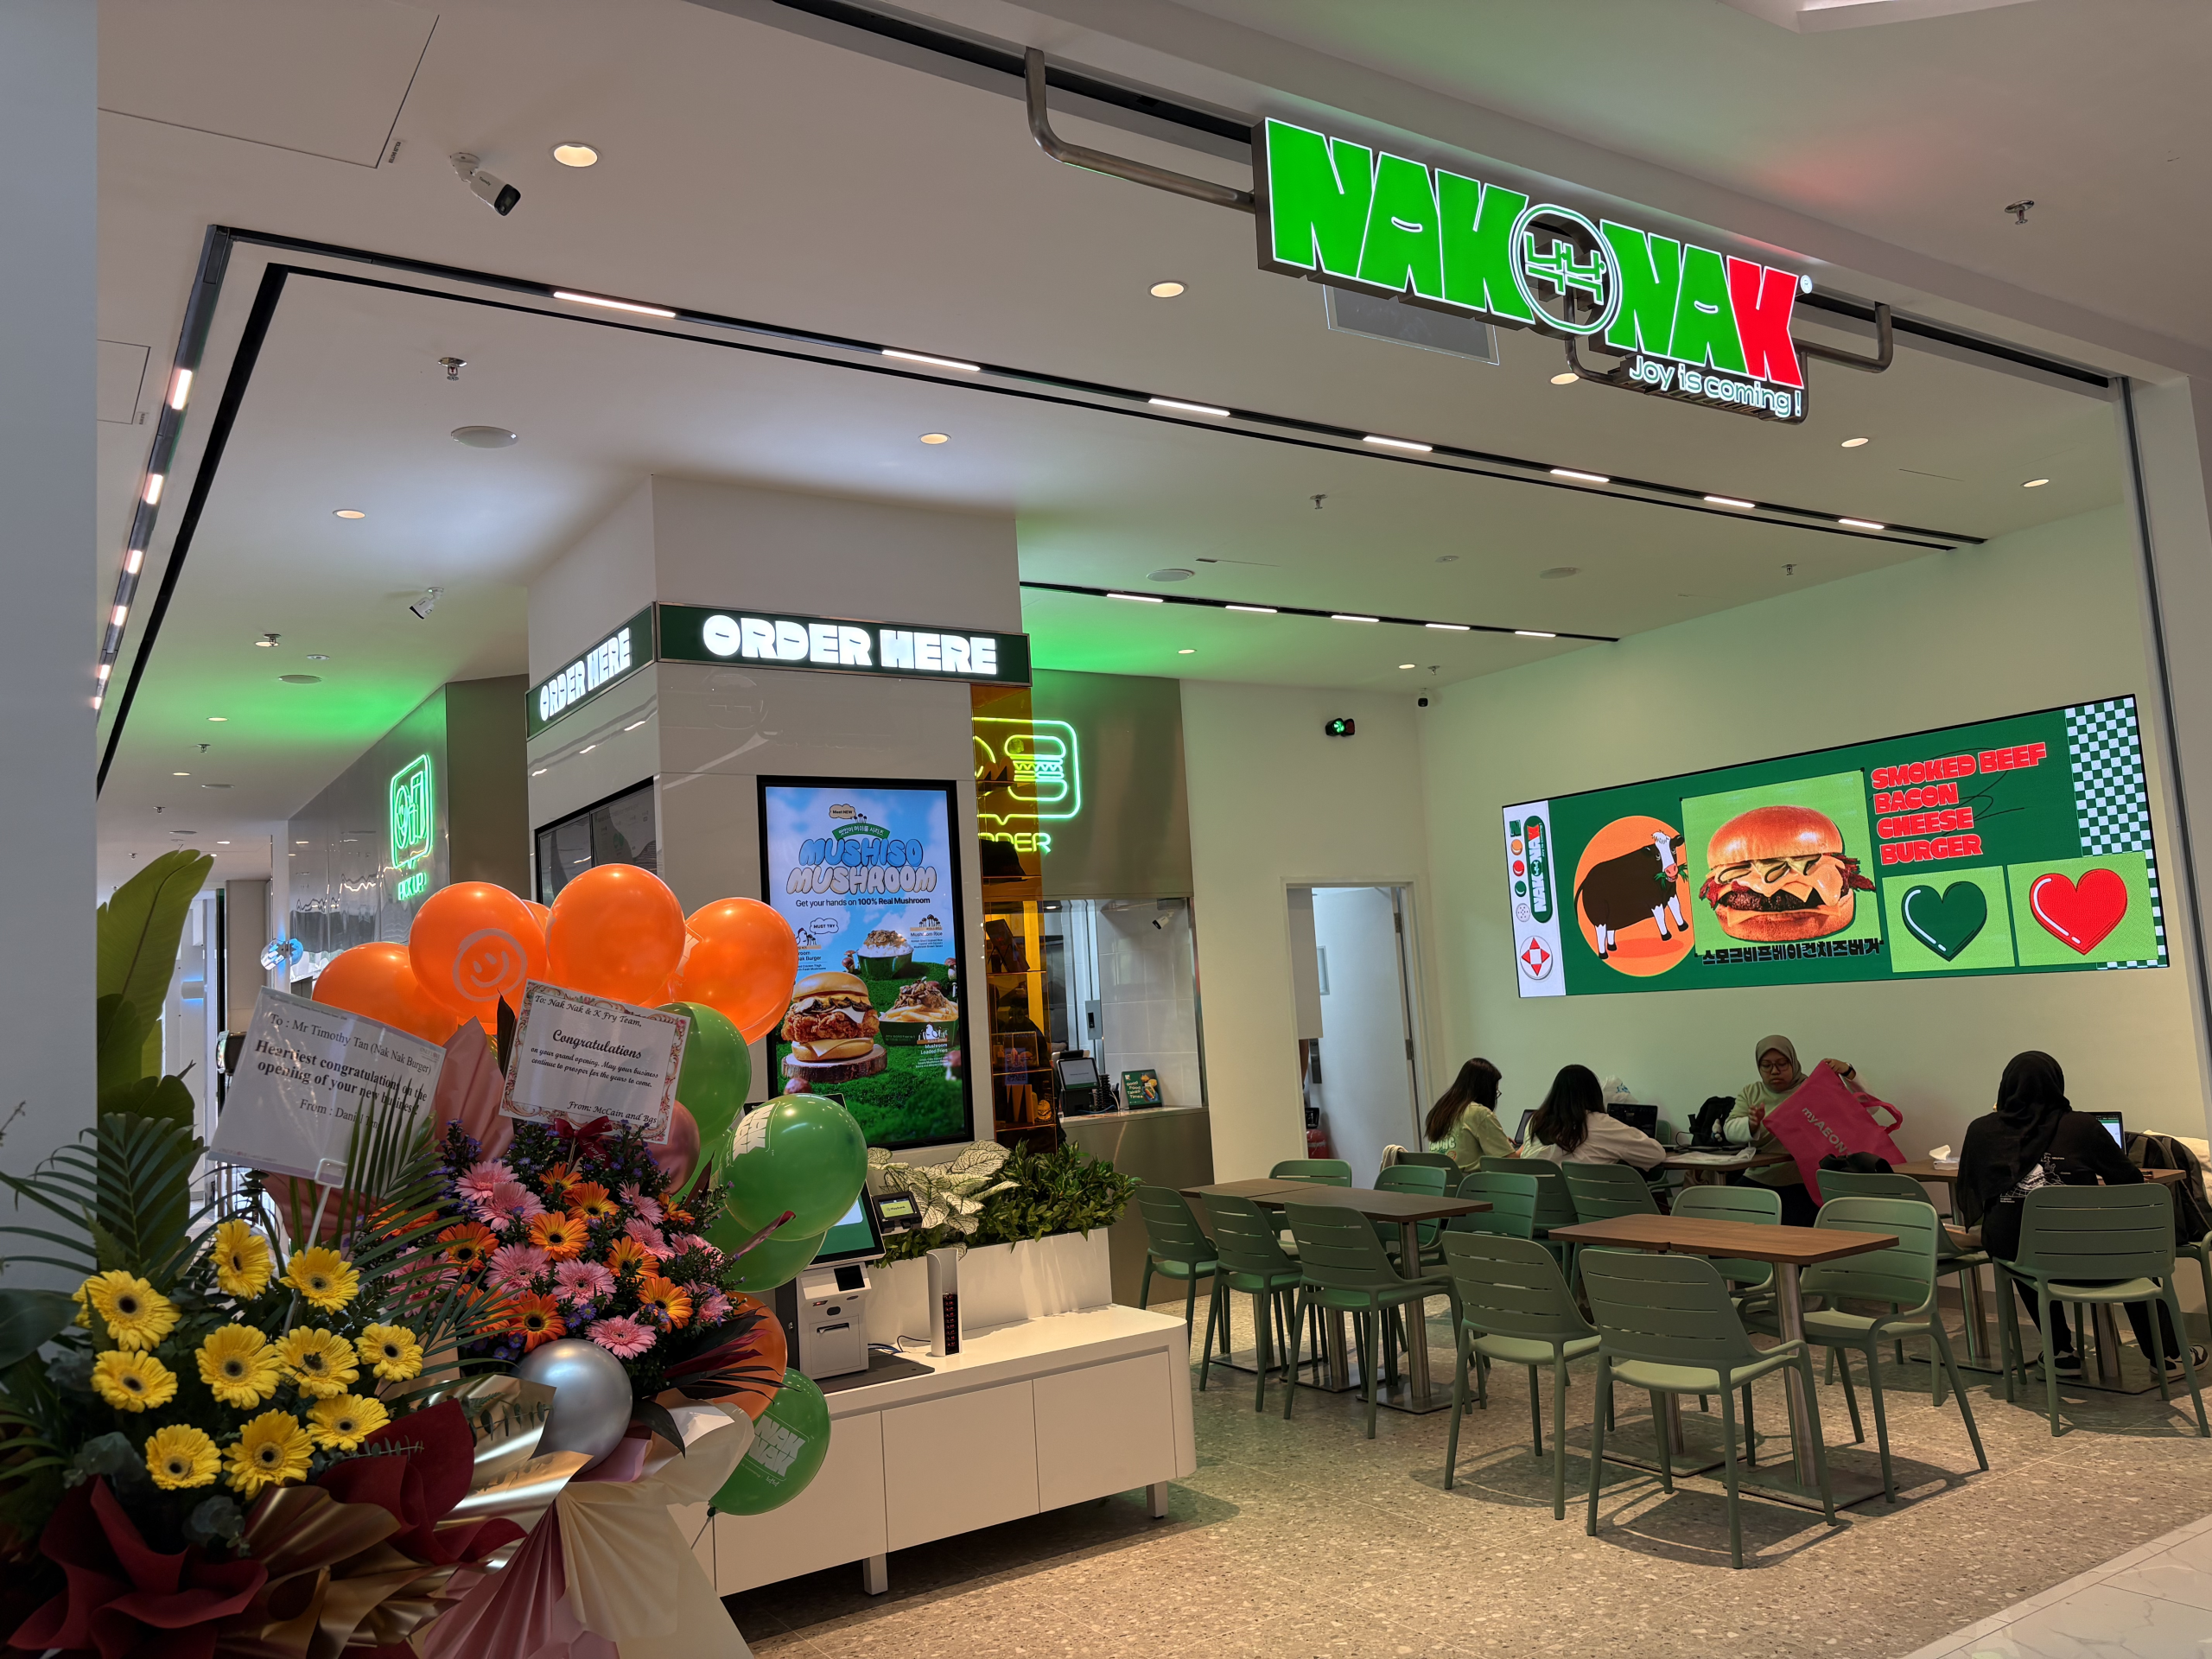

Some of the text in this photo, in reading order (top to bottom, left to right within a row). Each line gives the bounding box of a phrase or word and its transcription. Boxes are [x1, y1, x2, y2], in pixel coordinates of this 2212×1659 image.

[1265, 117, 1535, 324] NAK
[1599, 219, 1804, 389] NAK
[1629, 355, 1675, 391] Joy
[1678, 363, 1702, 393] is
[1704, 376, 1791, 418] coming
[702, 613, 998, 676] ORDER HERE
[540, 626, 632, 721] ORDER HERE
[1871, 741, 2047, 790] SMOKED BEEF
[1873, 782, 1959, 815] BACON
[1877, 806, 1974, 839] CHEESE
[798, 837, 924, 868] MUSHISO
[1879, 834, 1983, 865] BURGER
[786, 865, 938, 895] MUSHROOM
[810, 900, 825, 909] your
[535, 995, 546, 1005] To:
[548, 998, 565, 1009] Nak
[567, 1003, 583, 1014] Nak
[593, 1009, 601, 1018] K
[601, 1012, 617, 1025] Fry
[619, 1015, 642, 1027] Team,
[270, 1014, 283, 1026] To
[292, 1020, 308, 1033] Mr
[311, 1025, 351, 1046] Timothy
[353, 1036, 369, 1050] Tan
[370, 1042, 390, 1058] (Nak
[391, 1050, 406, 1064] Nak
[407, 1056, 431, 1075] Burger)
[552, 1029, 642, 1059] Congratulations
[255, 1039, 316, 1065] Heartiest
[320, 1058, 400, 1091] congratulations
[257, 1059, 311, 1084] opening
[314, 1068, 329, 1085] of
[328, 1078, 358, 1093] your
[531, 1058, 556, 1068] continue
[564, 1065, 588, 1075] prosper
[588, 1068, 599, 1077] for
[600, 1071, 609, 1079] the
[610, 1073, 627, 1083] years
[635, 1079, 652, 1088] come.
[555, 1052, 574, 1061] grand
[575, 1057, 600, 1068] opening.
[601, 1060, 617, 1071] May
[633, 1067, 658, 1078] business
[300, 1099, 327, 1116] From
[335, 1107, 364, 1124] Danil
[567, 1101, 592, 1113] From:
[593, 1105, 624, 1118] McCain
[625, 1111, 642, 1122] and
[754, 1414, 806, 1460] NAK
